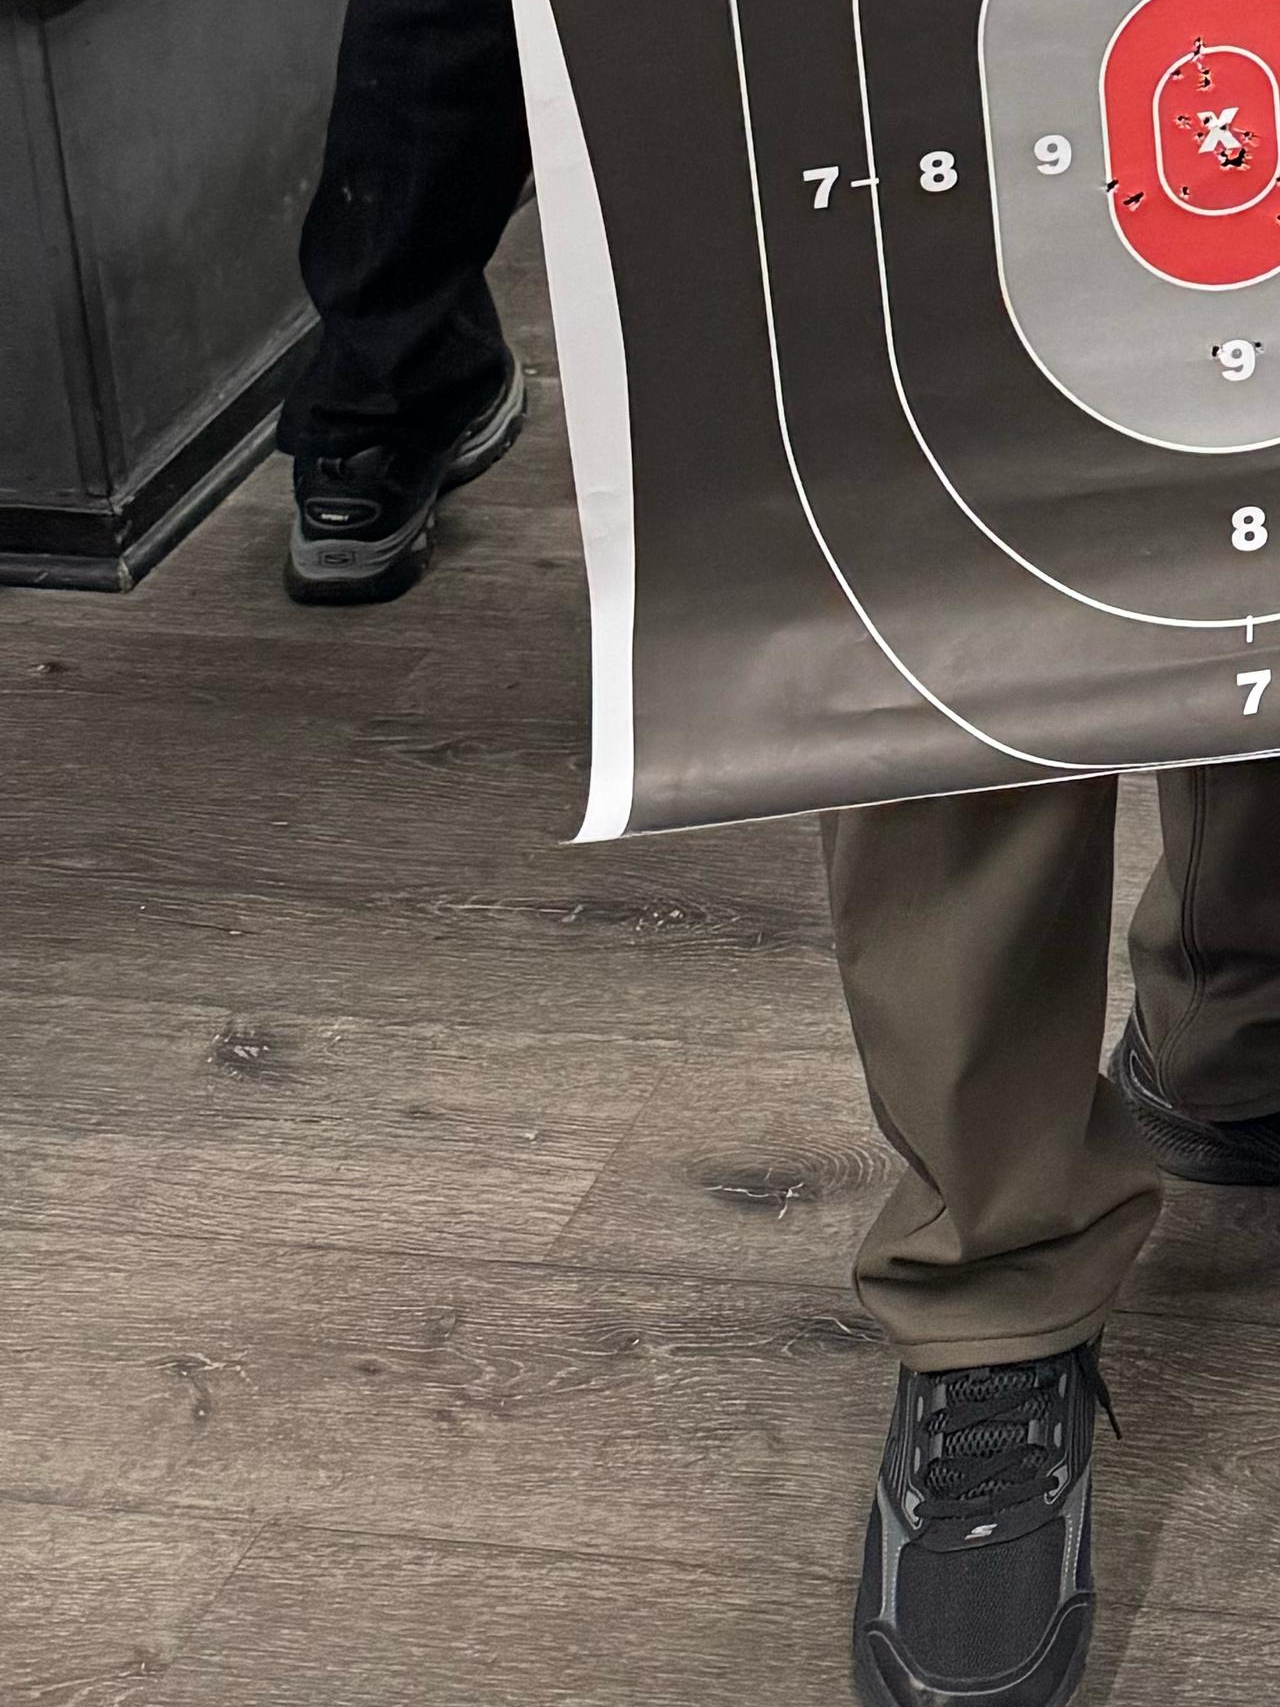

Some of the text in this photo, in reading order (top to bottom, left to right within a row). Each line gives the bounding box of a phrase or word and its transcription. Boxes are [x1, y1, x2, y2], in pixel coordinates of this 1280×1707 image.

[1196, 107, 1243, 154] X
[919, 150, 958, 192] 8
[1034, 134, 1073, 176] 9
[803, 165, 840, 209] 7
[1218, 339, 1257, 382] 9
[1231, 506, 1269, 552] 8
[1236, 668, 1272, 715] 7
